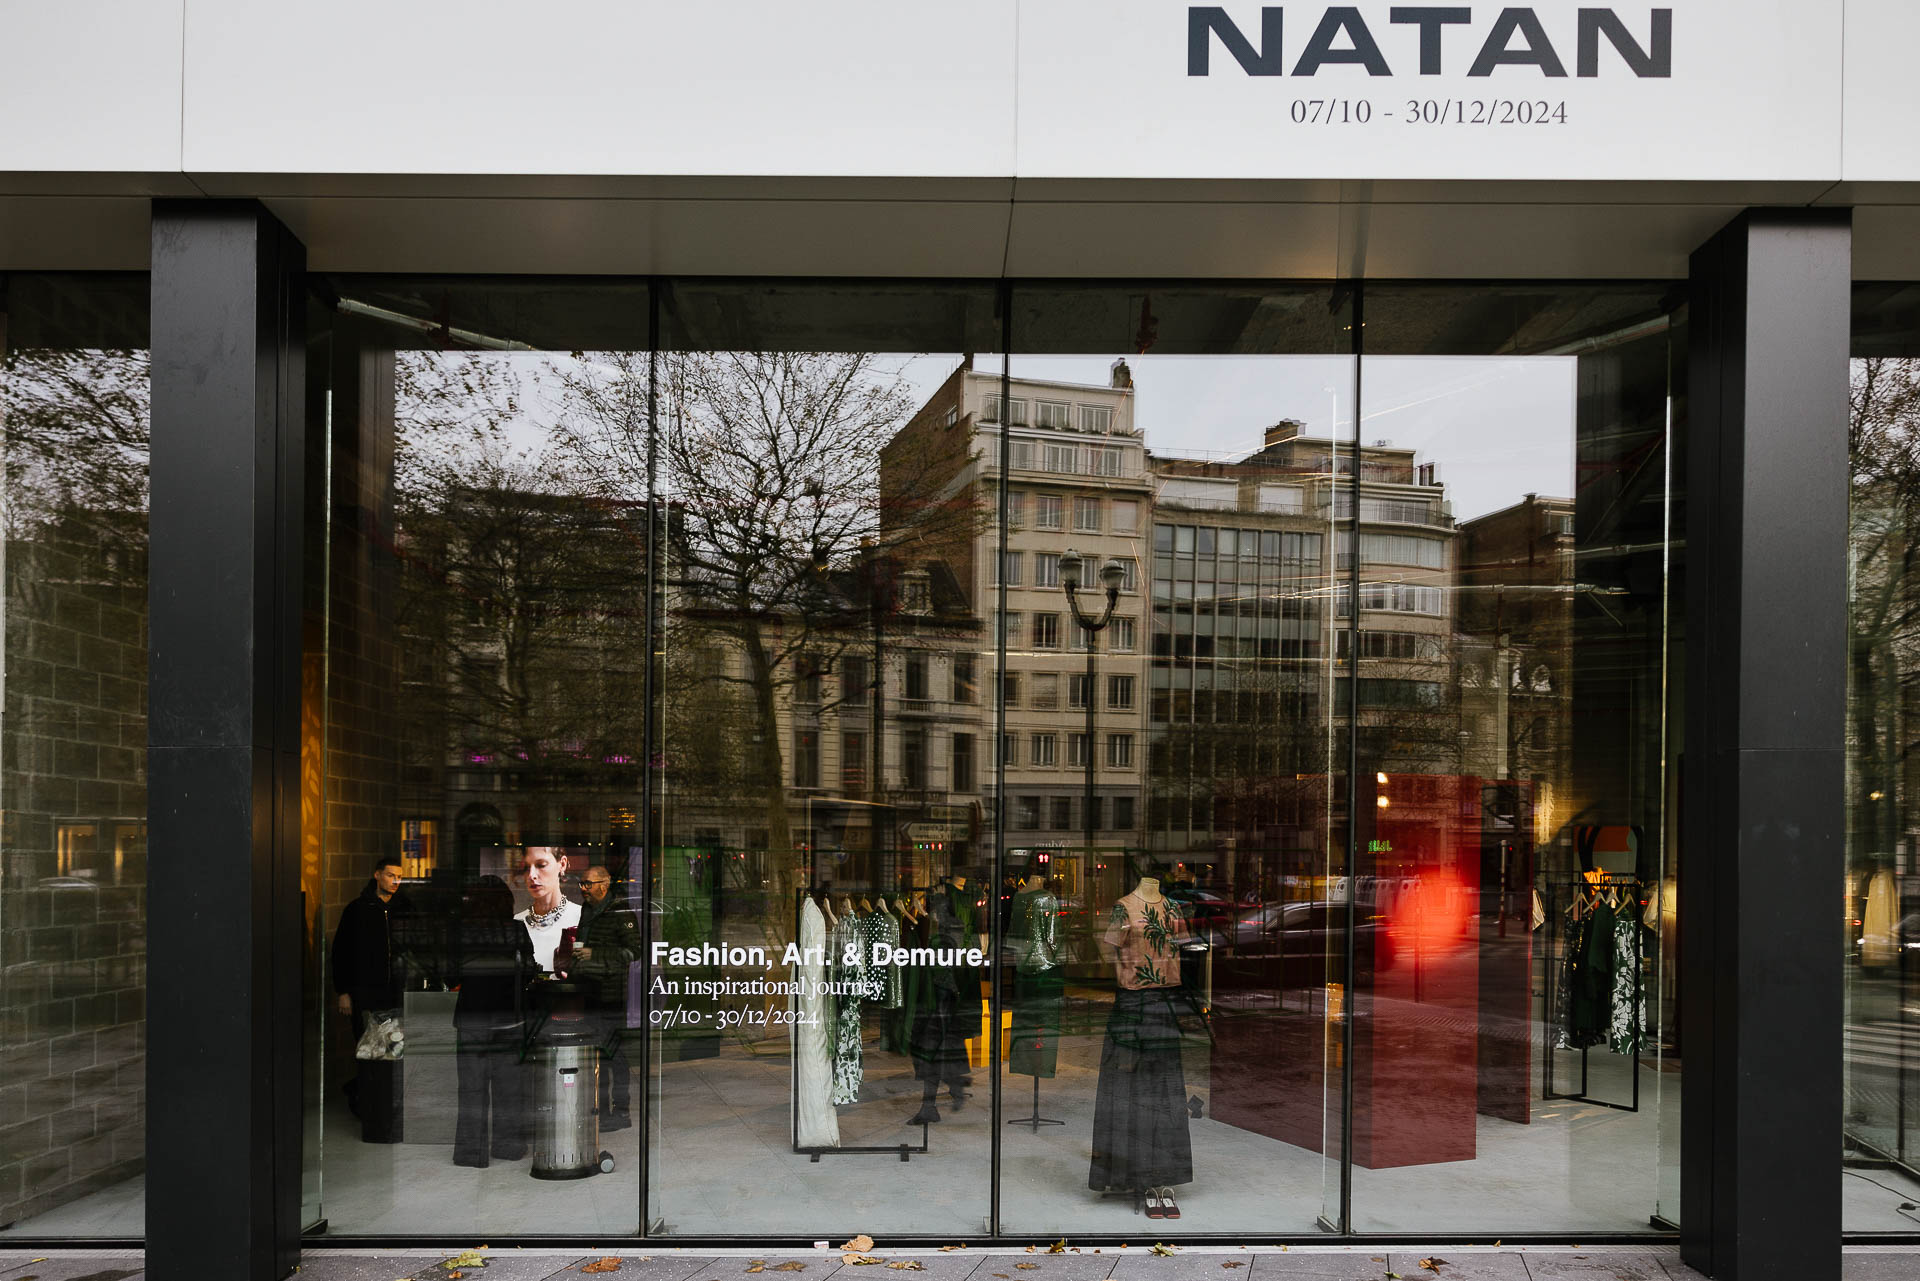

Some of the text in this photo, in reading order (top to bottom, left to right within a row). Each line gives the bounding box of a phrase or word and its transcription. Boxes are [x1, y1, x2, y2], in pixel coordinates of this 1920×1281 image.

[1187, 6, 1672, 78] NATAN
[1290, 98, 1372, 125] 07/10
[1405, 99, 1568, 126] 30/12/2024
[651, 942, 991, 970] Fashion, Art. & Demure.
[648, 975, 884, 1001] An inspirational journey
[649, 1004, 701, 1029] 07/10
[715, 1004, 819, 1029] 30/12/2024
